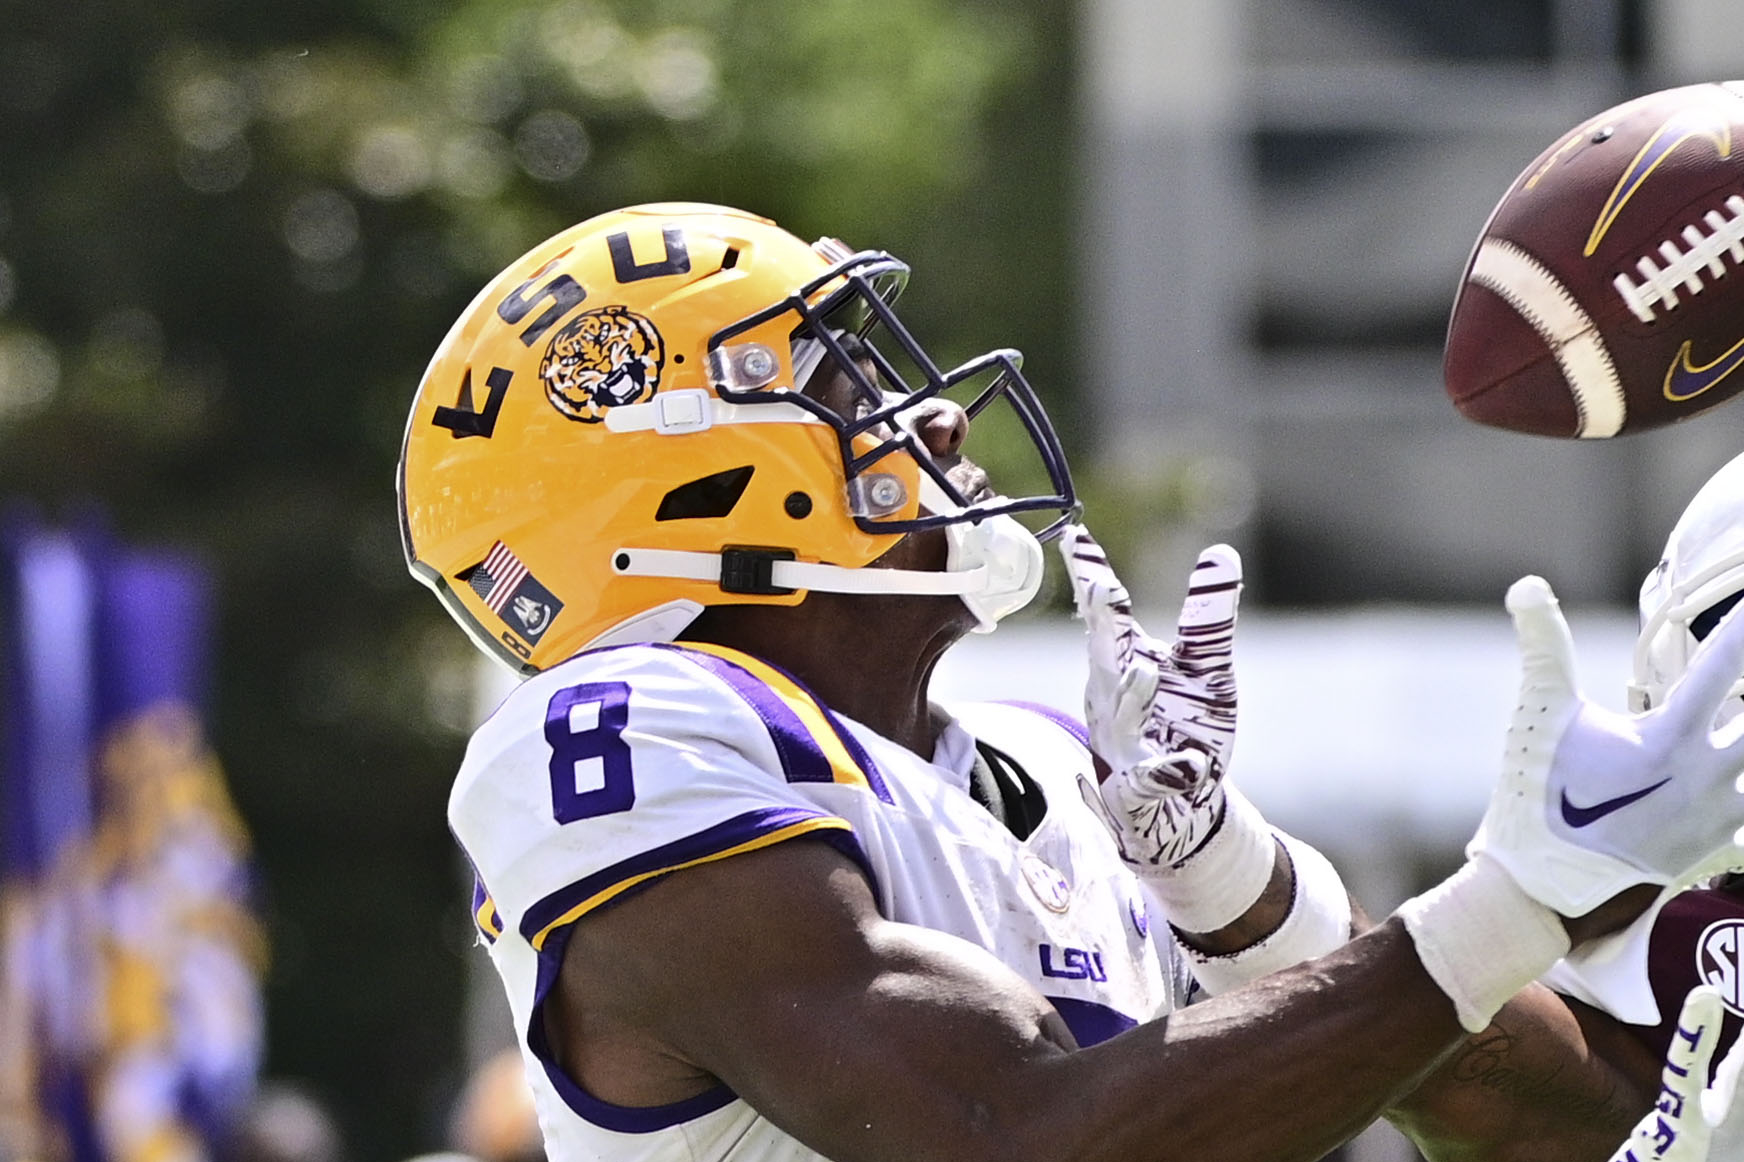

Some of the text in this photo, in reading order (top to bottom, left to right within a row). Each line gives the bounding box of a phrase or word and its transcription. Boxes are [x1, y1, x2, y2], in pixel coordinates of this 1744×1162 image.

[432, 222, 691, 439] LSU
[501, 630, 532, 660] 8
[544, 681, 636, 826] 8
[1038, 943, 1107, 982] LSU
